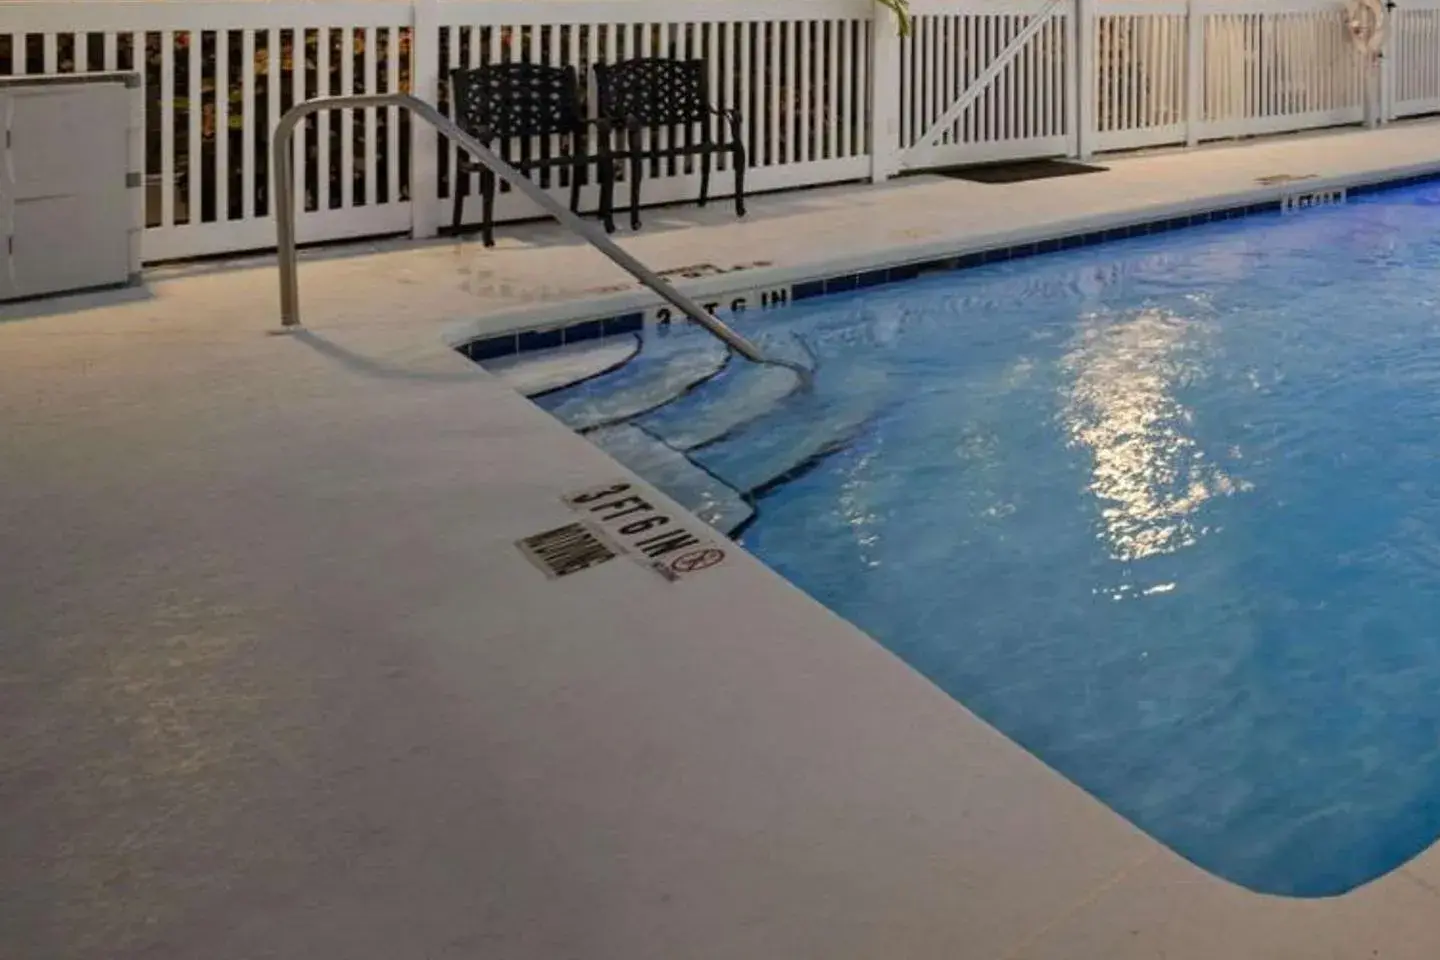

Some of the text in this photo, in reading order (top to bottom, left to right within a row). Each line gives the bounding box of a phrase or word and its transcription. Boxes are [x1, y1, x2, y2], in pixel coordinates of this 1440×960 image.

[572, 483, 632, 504] 3
[590, 495, 654, 522] FT
[619, 515, 670, 535] 6
[635, 528, 700, 558] IN
